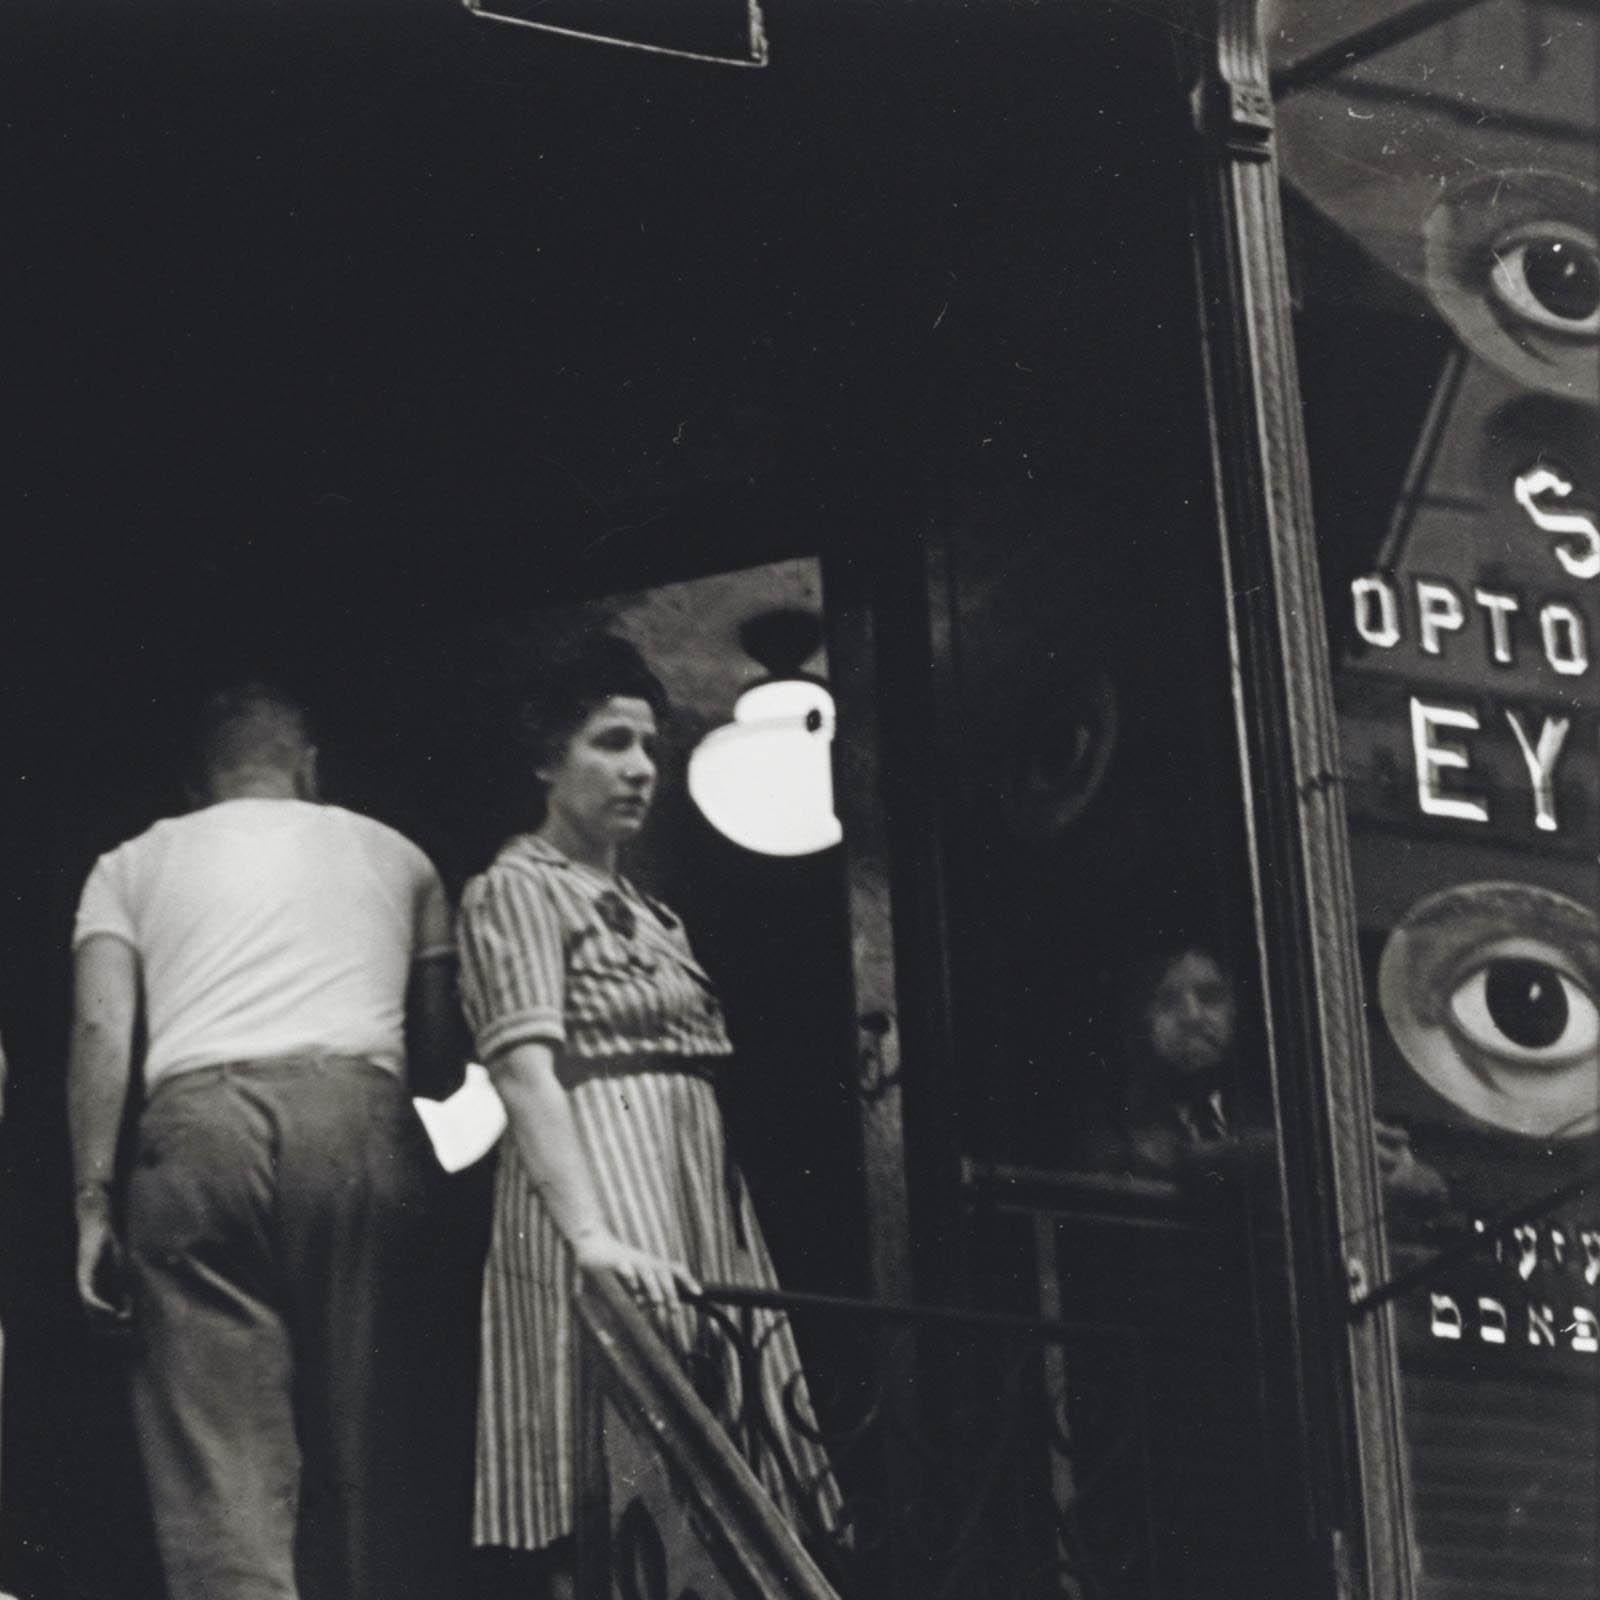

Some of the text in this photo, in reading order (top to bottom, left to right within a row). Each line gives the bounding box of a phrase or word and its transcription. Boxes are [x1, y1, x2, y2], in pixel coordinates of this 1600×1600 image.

[1514, 467, 1600, 579] S
[1350, 574, 1589, 676] OPTO
[1411, 696, 1570, 831] EY
